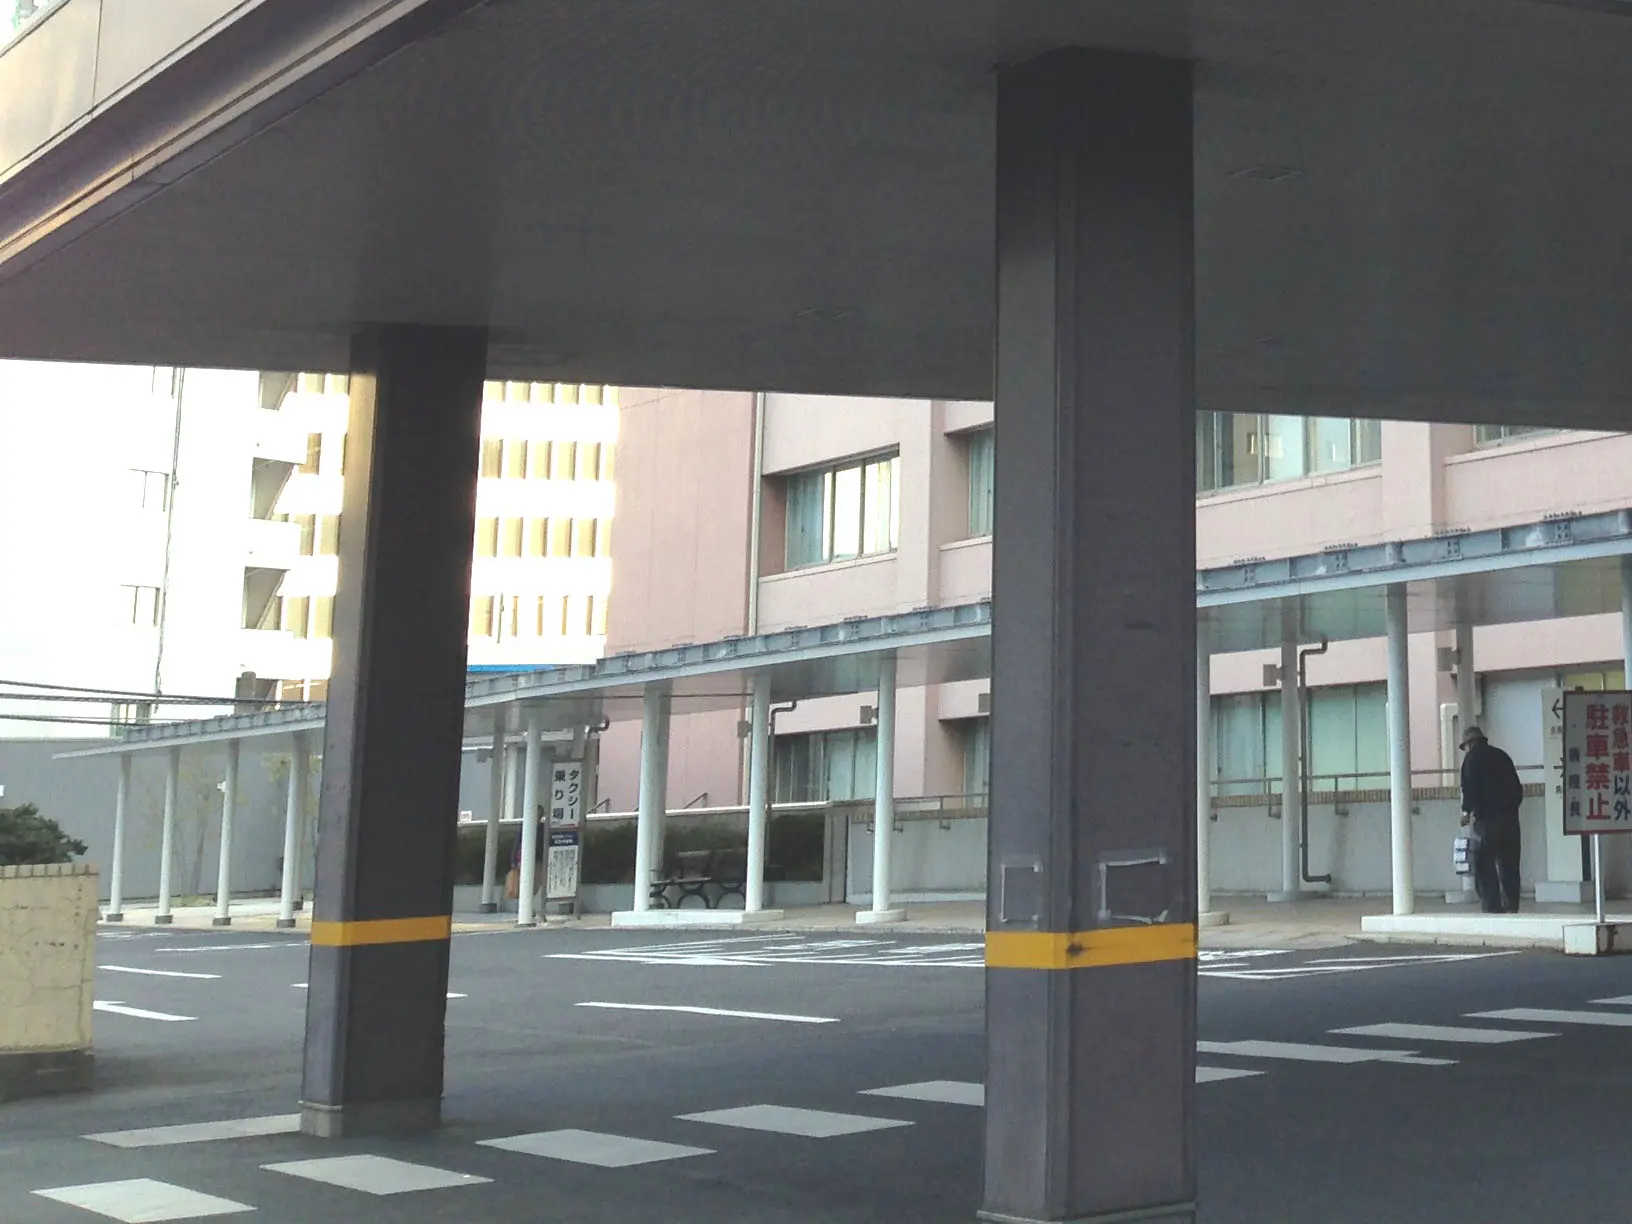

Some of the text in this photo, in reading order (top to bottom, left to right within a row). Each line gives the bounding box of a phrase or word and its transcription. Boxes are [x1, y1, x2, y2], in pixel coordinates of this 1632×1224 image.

[553, 770, 566, 819] 乗り場
[568, 769, 579, 819] タクシー
[1585, 704, 1611, 820] 駐車禁止
[1612, 702, 1631, 821] 救急車以外
